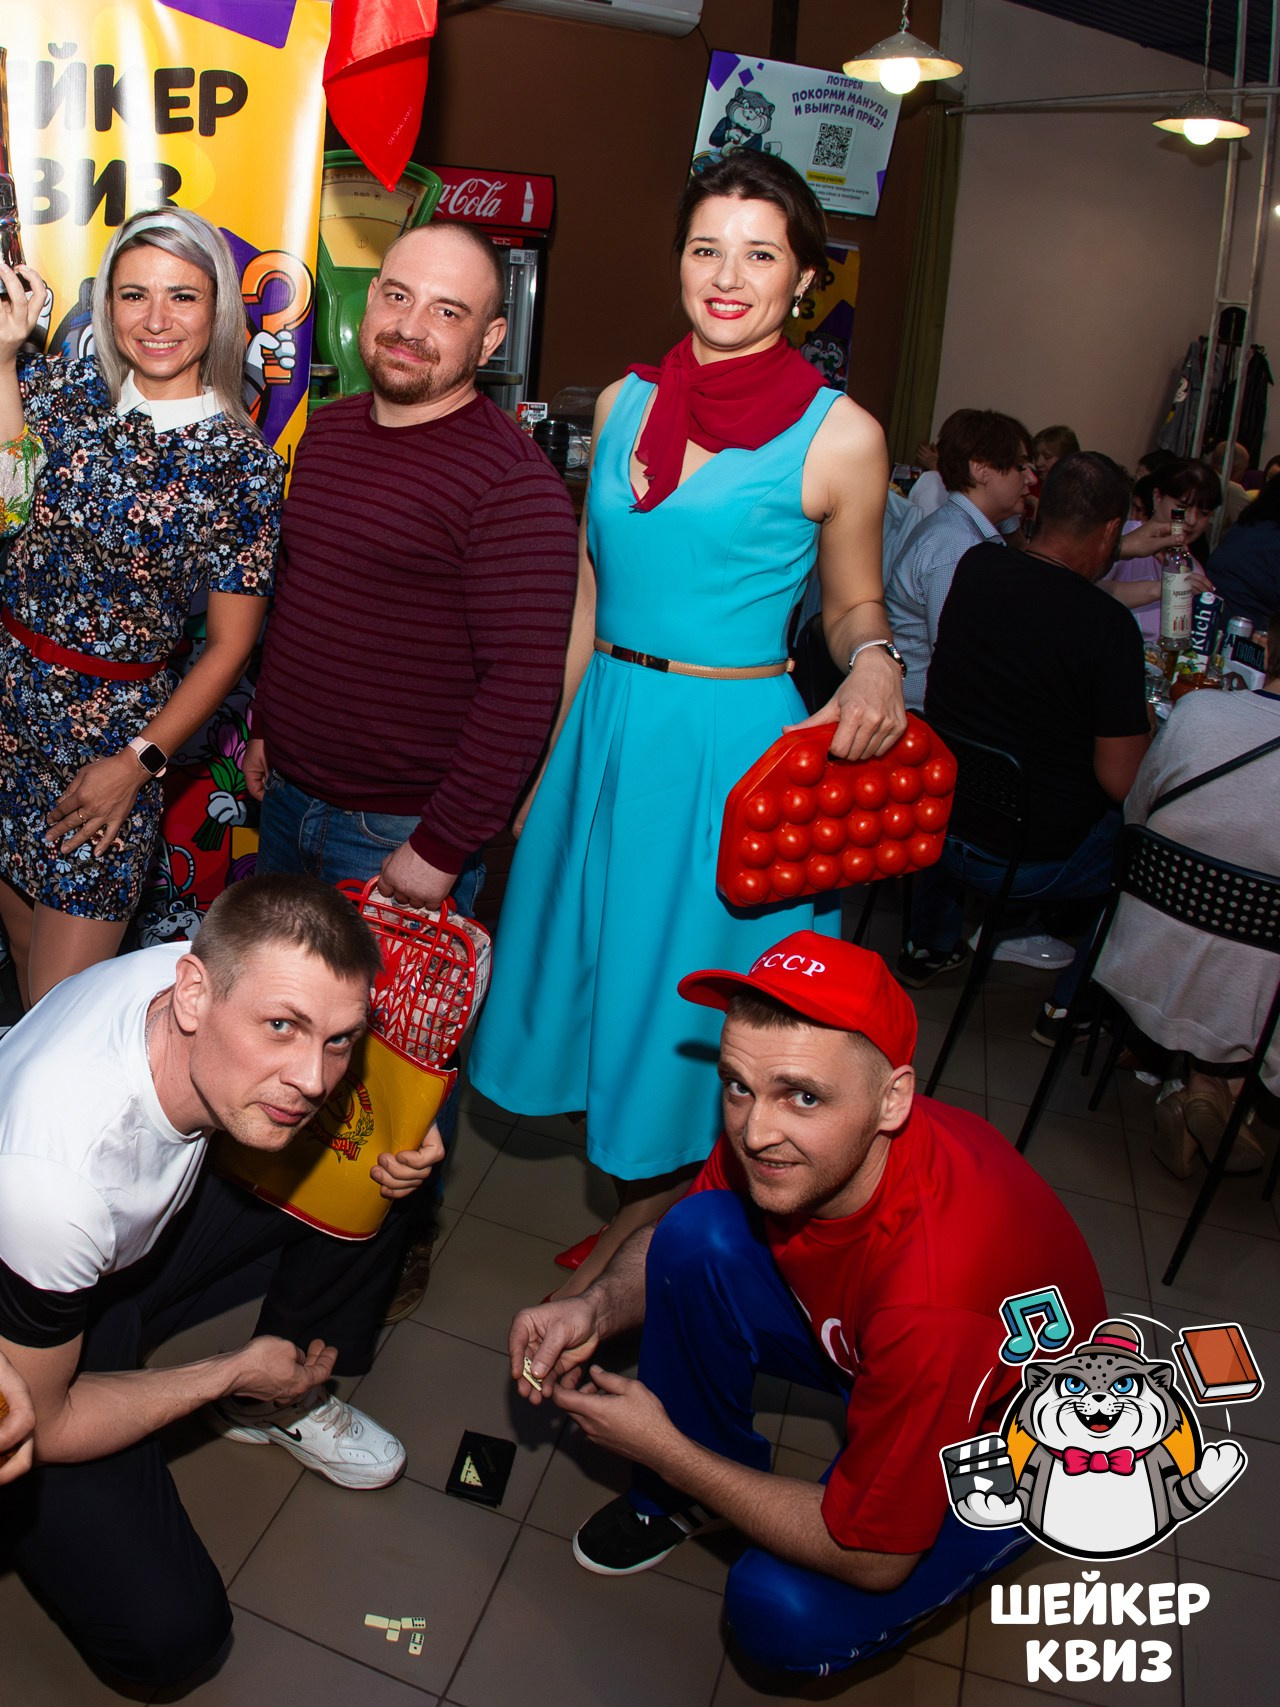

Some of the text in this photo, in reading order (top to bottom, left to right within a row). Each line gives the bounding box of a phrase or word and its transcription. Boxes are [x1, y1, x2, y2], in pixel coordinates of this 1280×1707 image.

[826, 75, 863, 90] ЛОТЕРЕЯ
[792, 88, 889, 119] ПОКОРМИ МАНУЛА
[795, 102, 884, 130] И ВЫИГРАЙ ПРИЗ!
[751, 953, 825, 977] СССР
